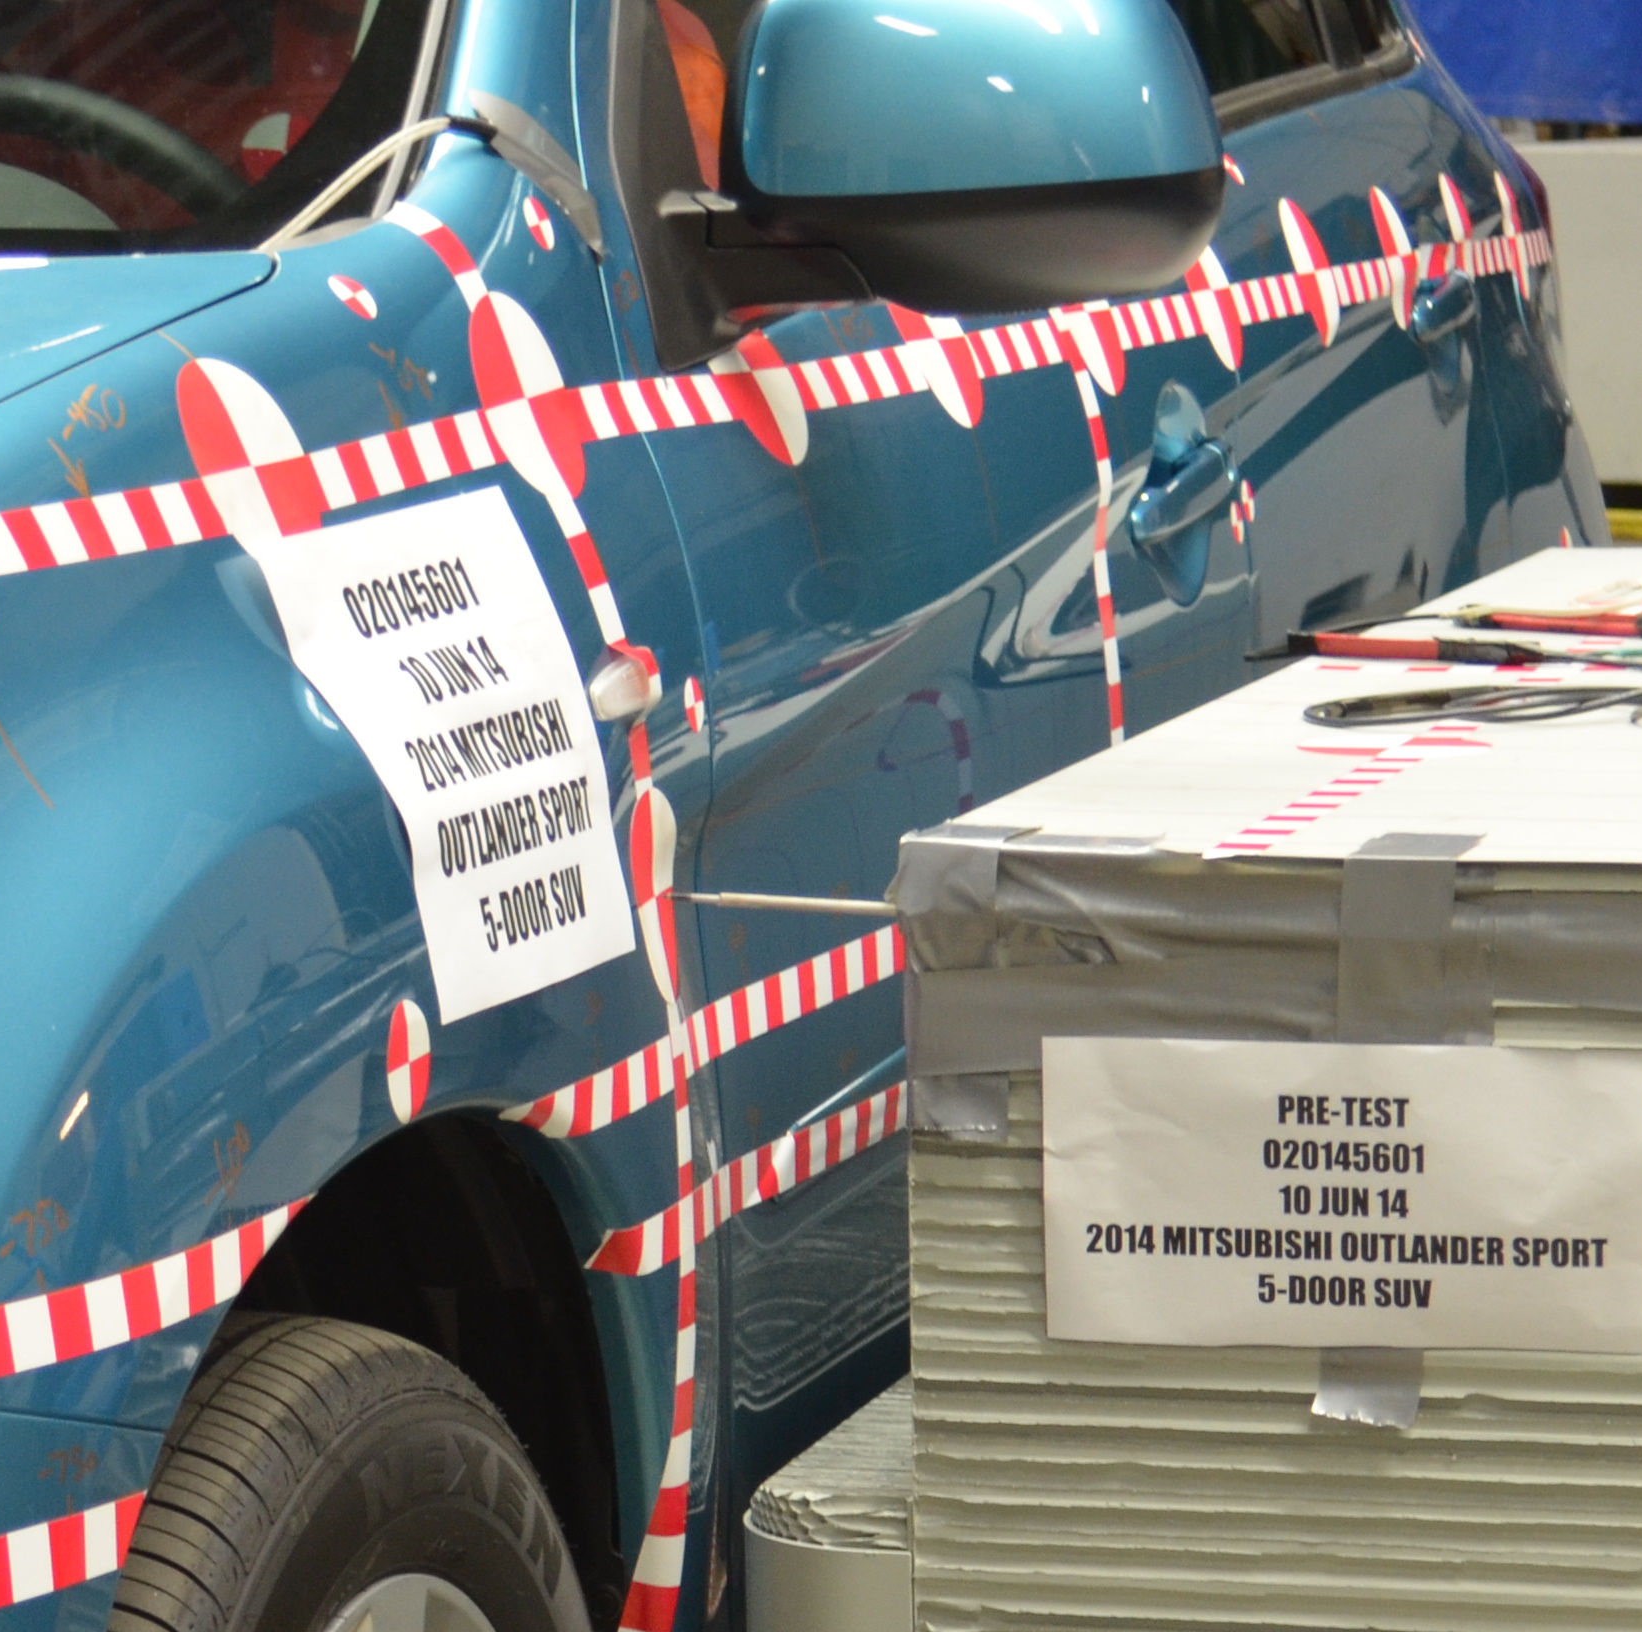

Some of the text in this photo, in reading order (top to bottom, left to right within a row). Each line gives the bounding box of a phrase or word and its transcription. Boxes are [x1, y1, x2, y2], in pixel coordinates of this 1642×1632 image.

[398, 636, 510, 705] 10 JUN 14
[404, 698, 573, 792] 2014 MITSUBISHI
[437, 775, 592, 878] OUTLANDER SPORT
[479, 864, 586, 952] 5-DOOR SUV
[1277, 1094, 1410, 1128] PRE-TEST
[1278, 1185, 1409, 1218] 10 JUN 14
[1086, 1223, 1608, 1267] 2014 MITSUBISHI OUTLANDER SPORT
[1258, 1274, 1432, 1308] 5-DOOR SUV
[359, 1430, 564, 1602] NEXEN
